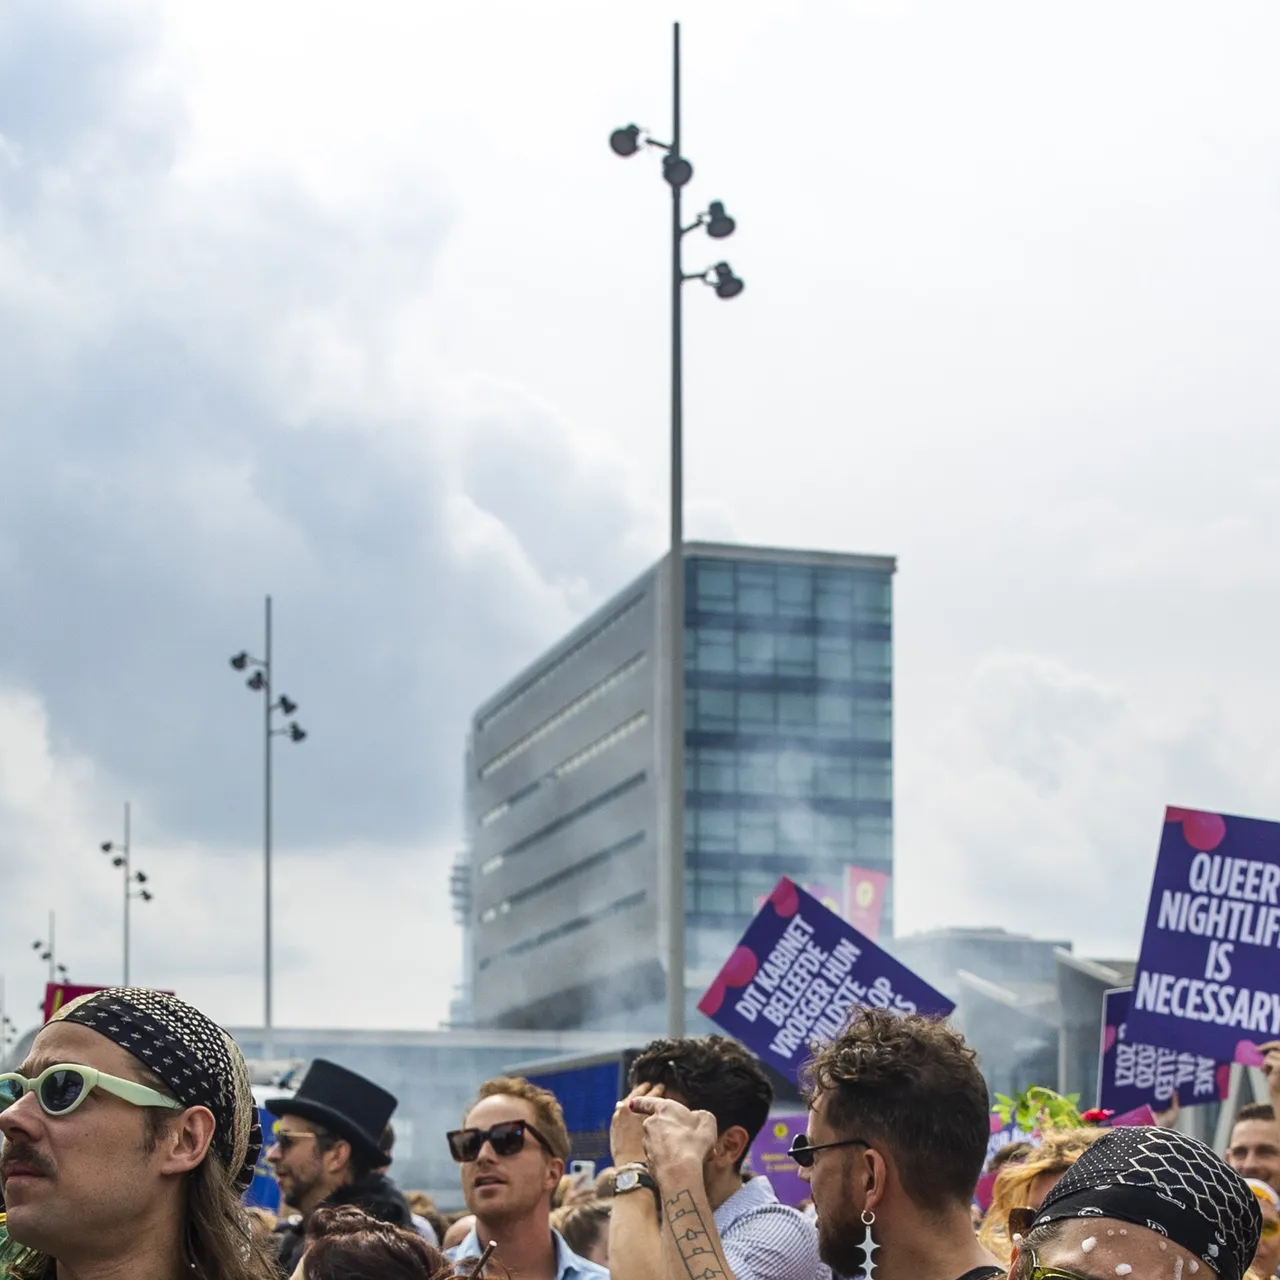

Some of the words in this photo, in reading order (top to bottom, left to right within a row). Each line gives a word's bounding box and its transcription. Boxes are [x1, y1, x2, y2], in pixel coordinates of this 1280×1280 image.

[734, 984, 769, 1023] DIT
[756, 913, 815, 993] KABINET
[761, 941, 828, 1028] BELEEFDE
[769, 978, 835, 1059] VROEGER
[821, 937, 862, 990] HUN
[1204, 942, 1234, 981] IS
[1114, 1042, 1137, 1087] 2021
